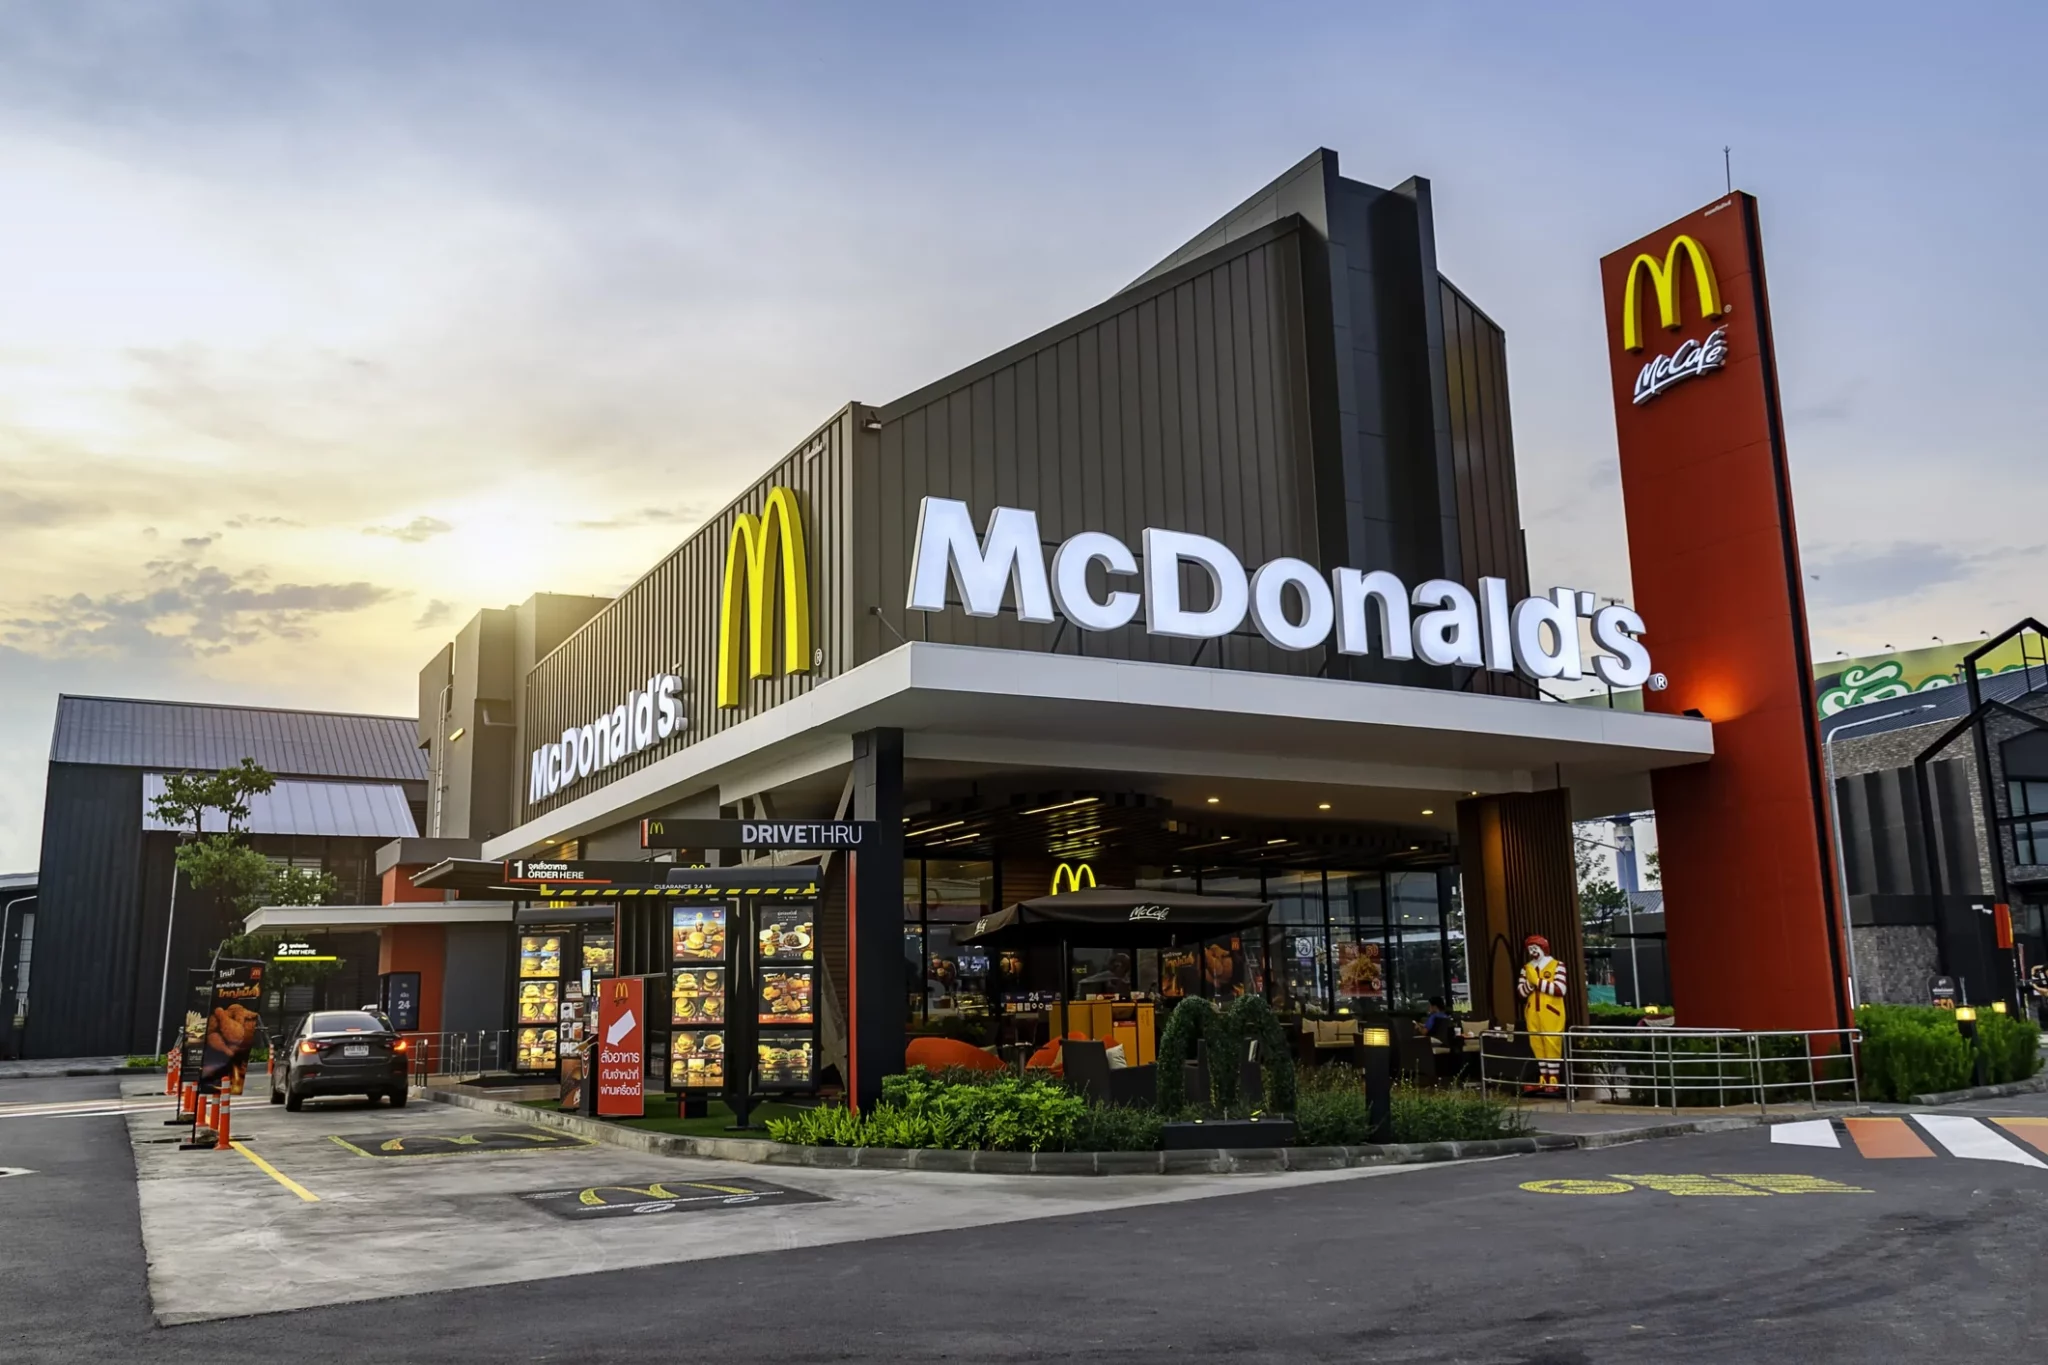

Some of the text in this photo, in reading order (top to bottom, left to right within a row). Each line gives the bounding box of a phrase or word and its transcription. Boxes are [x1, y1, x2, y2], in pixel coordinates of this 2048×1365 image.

[1632, 328, 1728, 405] McCafé
[906, 495, 1653, 688] McDonald's
[530, 673, 685, 805] McDonald's
[513, 860, 524, 879] 1
[527, 871, 584, 879] ORDER HERE
[277, 943, 288, 956] 2
[600, 1046, 640, 1064] สั่งอาหาร
